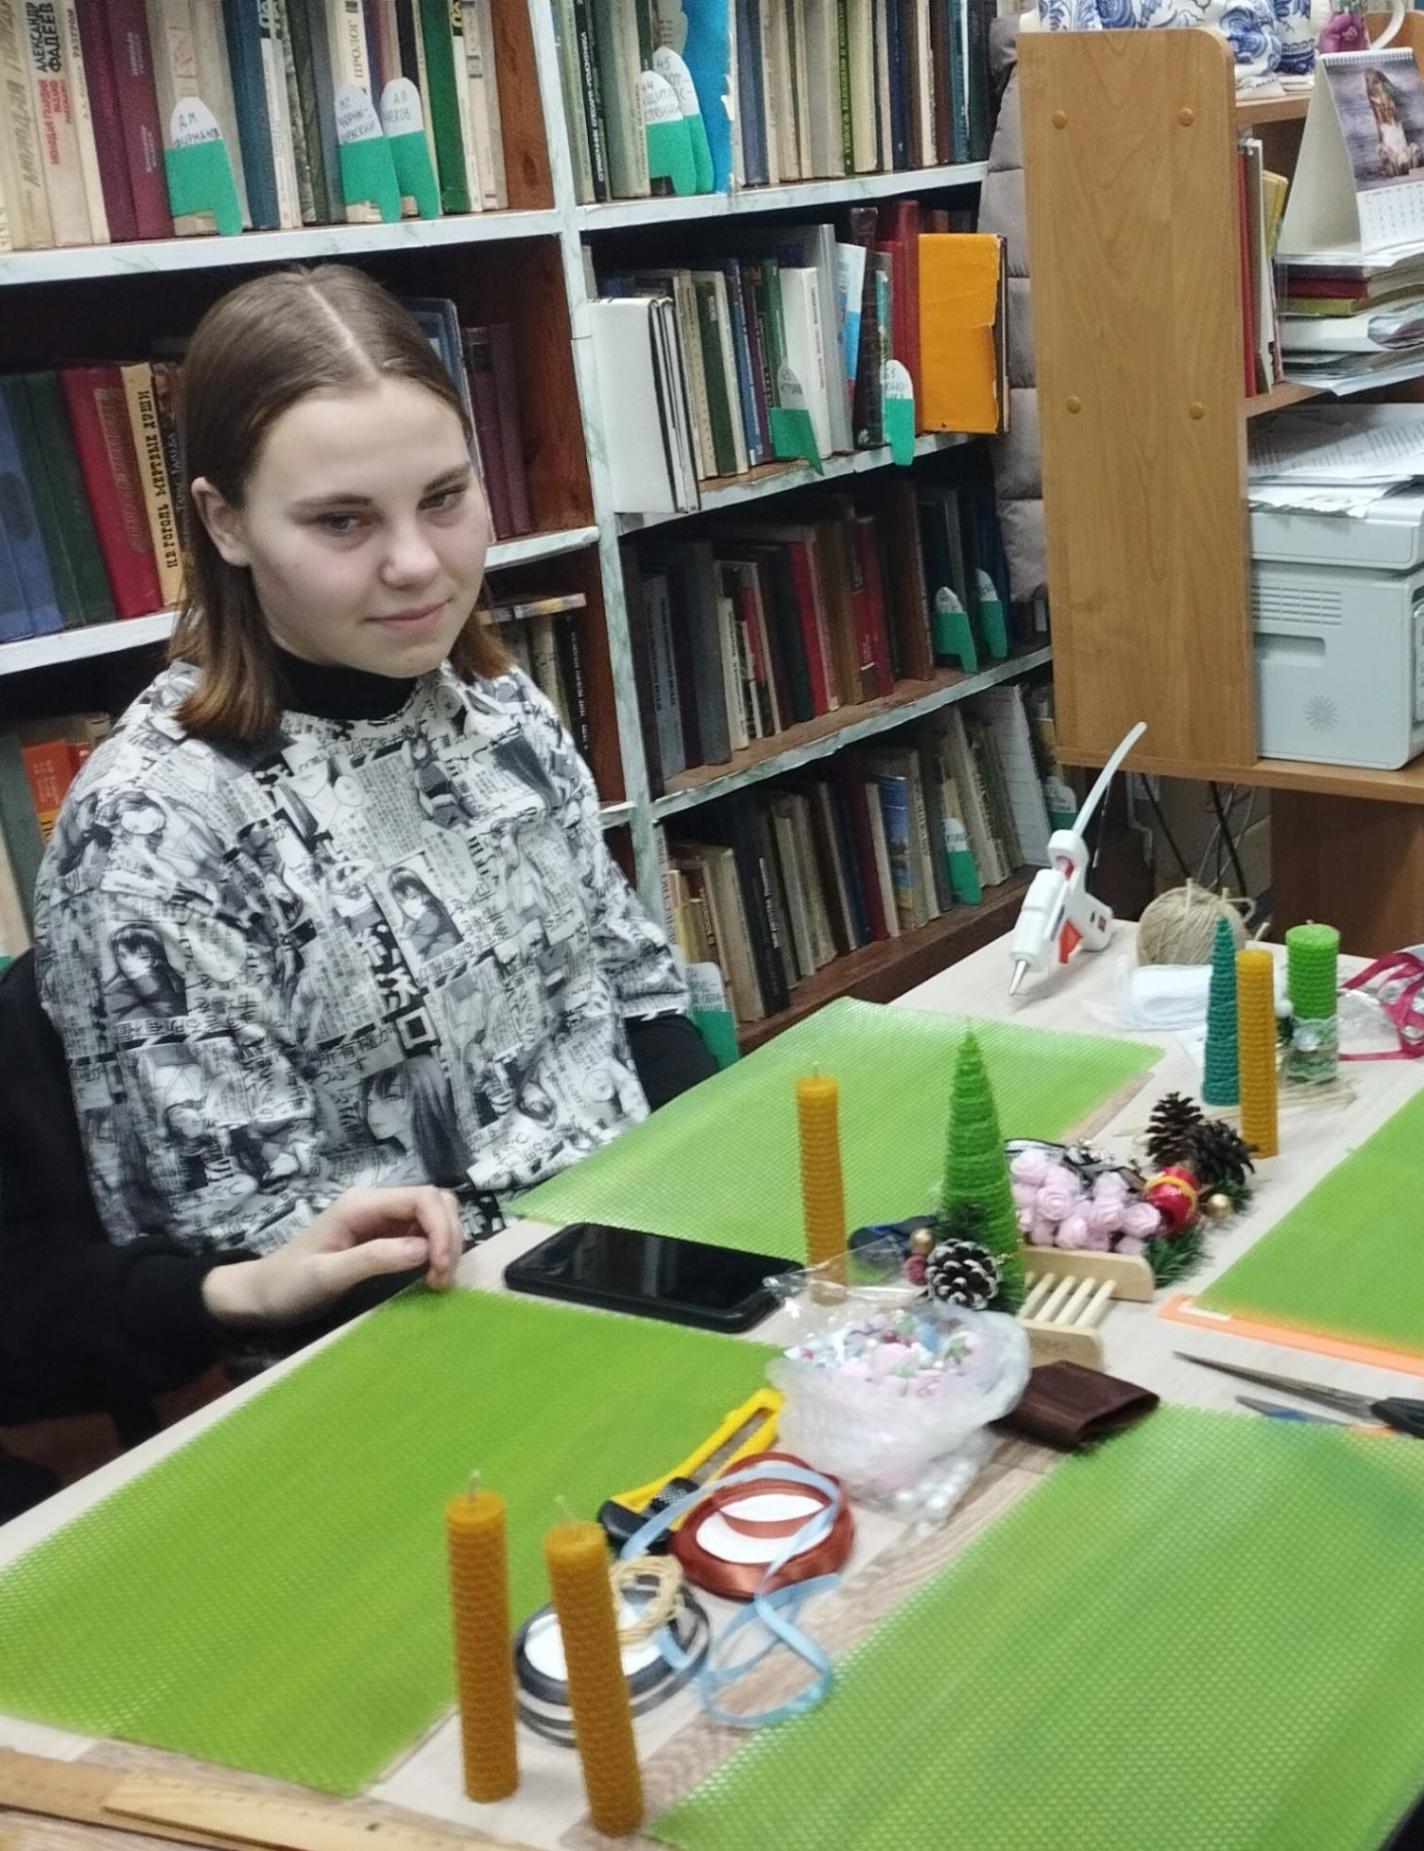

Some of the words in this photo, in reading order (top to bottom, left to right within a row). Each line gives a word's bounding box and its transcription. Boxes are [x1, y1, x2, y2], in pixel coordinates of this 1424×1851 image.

[25, 1, 48, 73] АЛЕКСАНДР
[39, 2, 62, 73] ФАДЕЕВ
[67, 8, 81, 58] РАЗГРОМ
[348, 19, 364, 78] ПРОЛОГ
[137, 390, 156, 430] ДУШИ
[145, 434, 168, 497] МЕРТВЫЕ
[158, 503, 174, 547] ГОГОЛЬ
